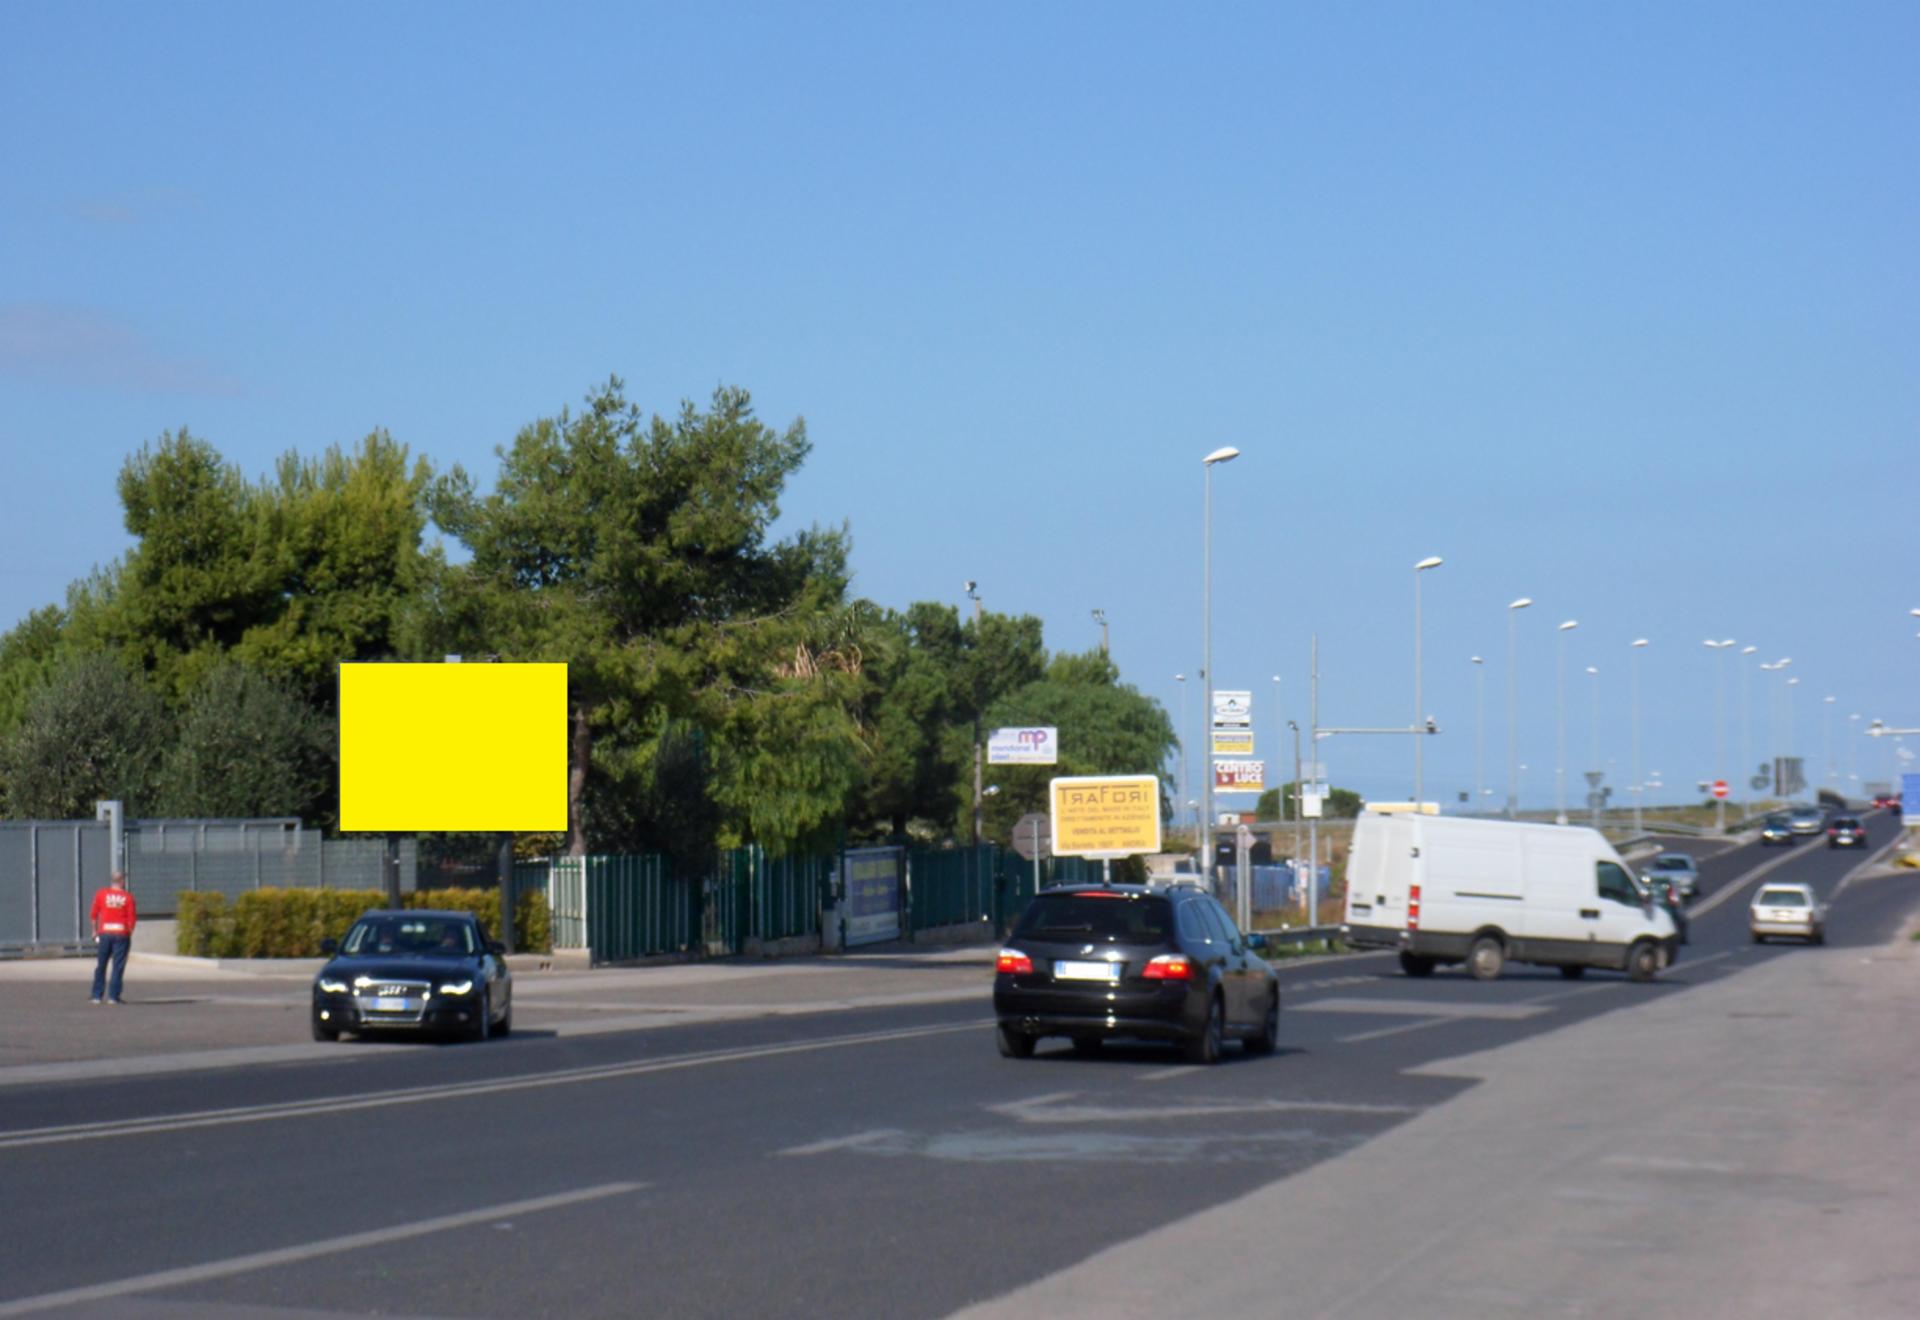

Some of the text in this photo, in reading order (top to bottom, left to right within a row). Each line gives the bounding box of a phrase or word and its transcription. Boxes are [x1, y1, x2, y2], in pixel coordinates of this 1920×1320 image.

[1018, 730, 1047, 751] mp
[1216, 763, 1262, 774] CENTRO
[1234, 773, 1262, 783] LUCE
